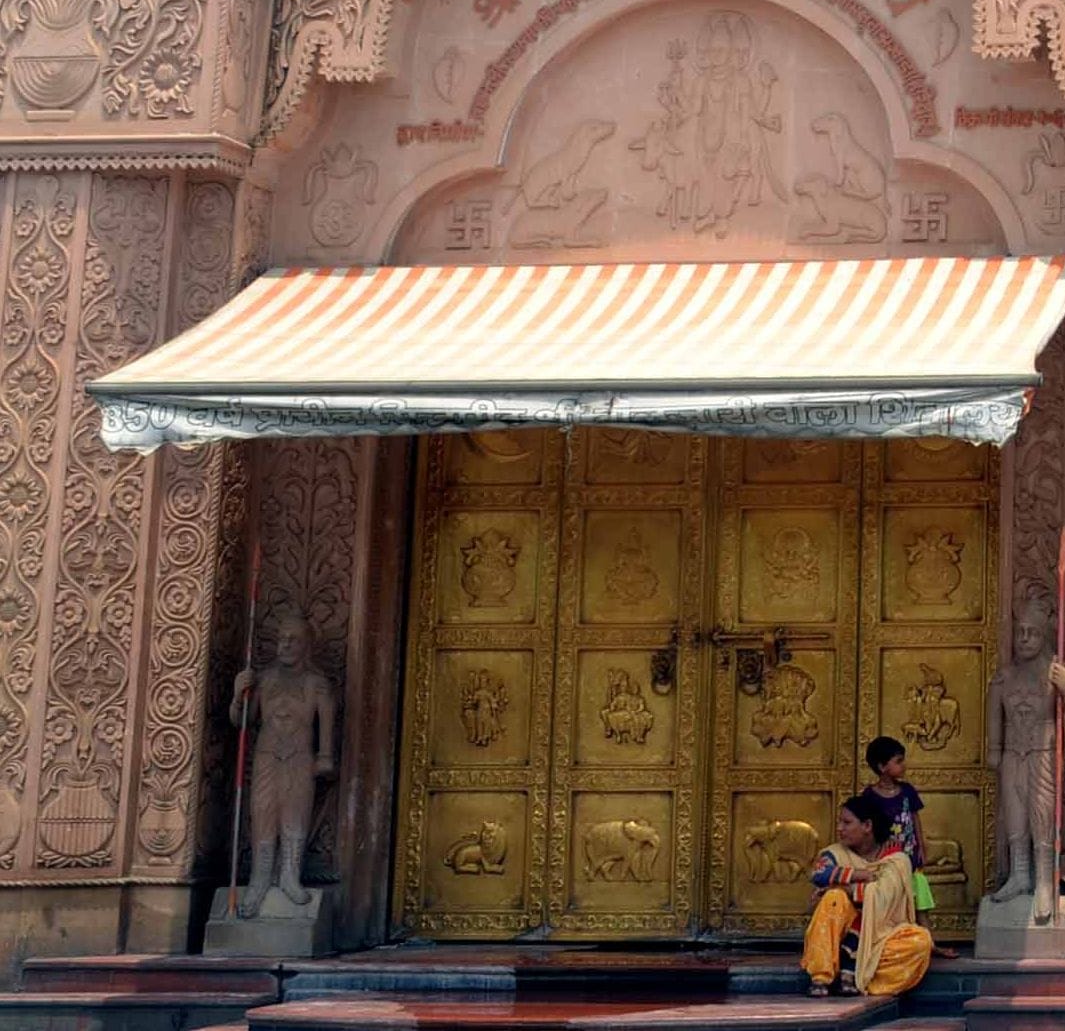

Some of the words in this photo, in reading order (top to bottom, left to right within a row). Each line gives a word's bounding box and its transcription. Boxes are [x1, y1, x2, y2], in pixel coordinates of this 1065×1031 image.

[102, 399, 177, 433] 850
[186, 397, 243, 428] वर्ष
[254, 398, 366, 432] प्राचीन
[762, 400, 859, 426] वाला
